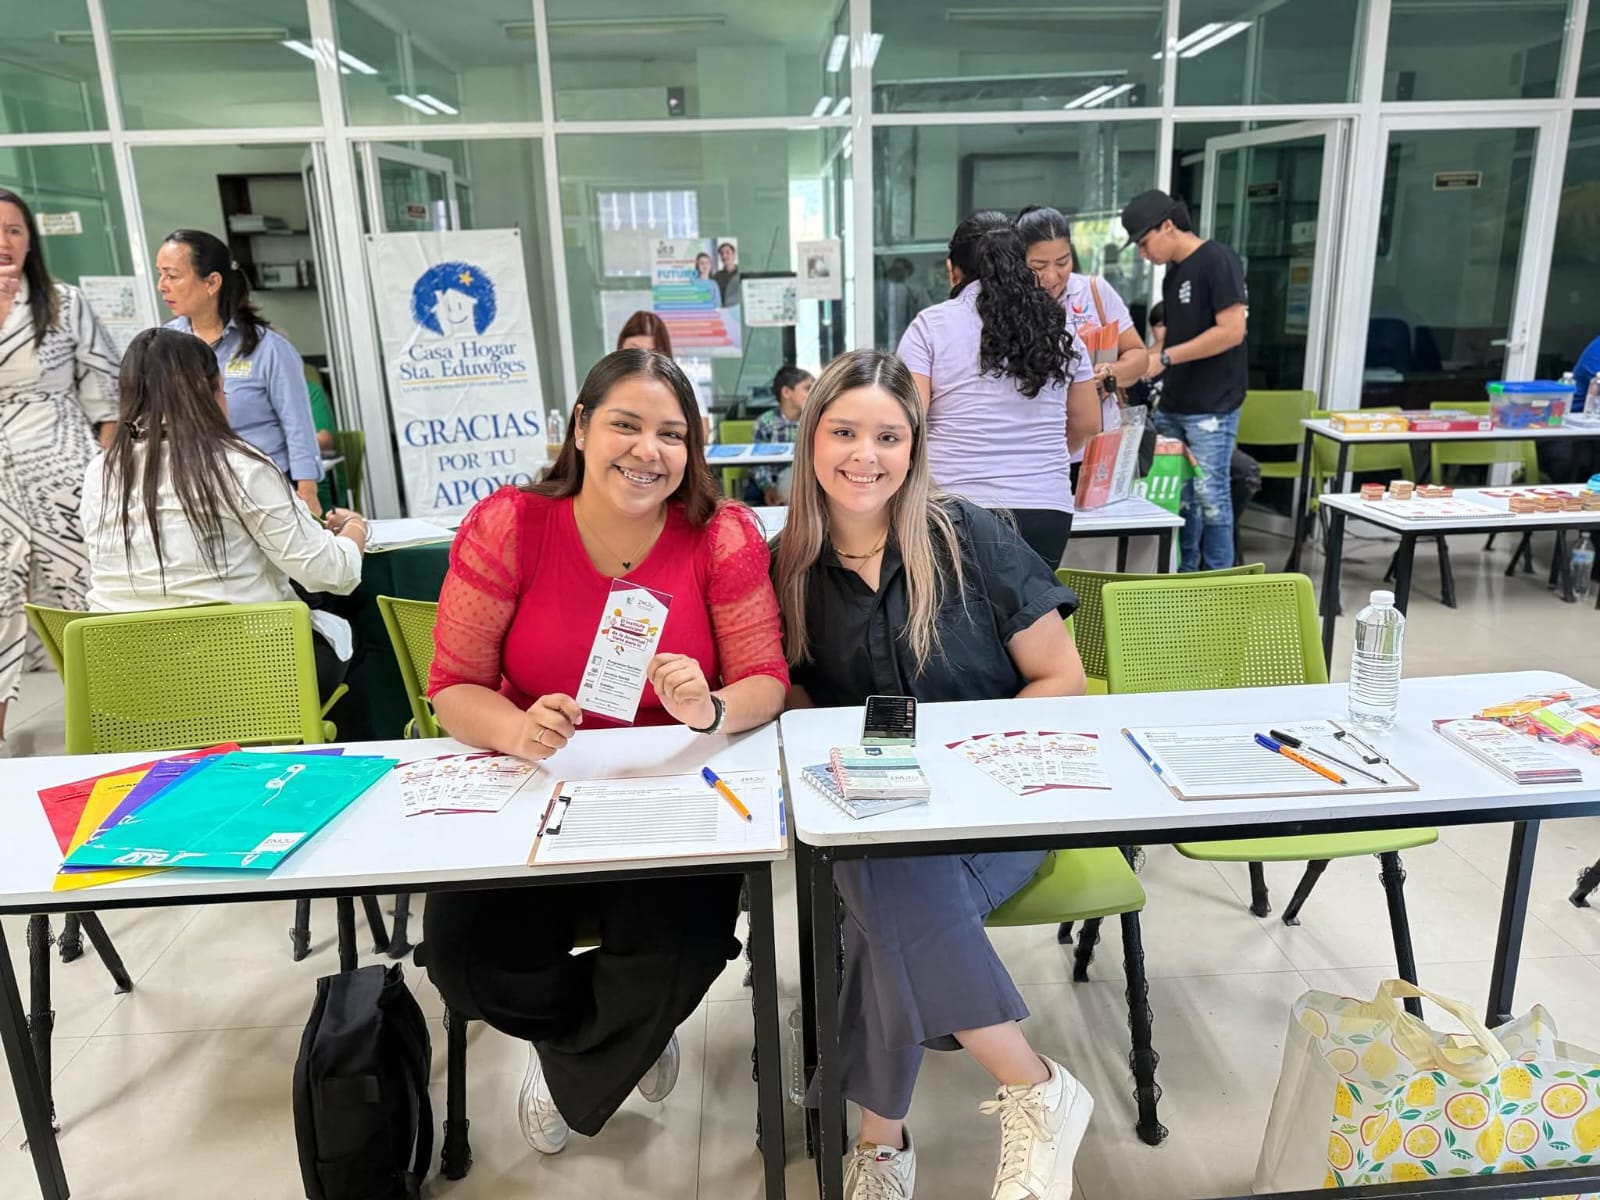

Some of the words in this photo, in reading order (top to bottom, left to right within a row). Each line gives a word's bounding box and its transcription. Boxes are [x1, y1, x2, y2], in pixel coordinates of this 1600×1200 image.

[408, 344, 454, 361] Casa
[461, 341, 517, 361] Hogar
[400, 362, 434, 380] Sta.
[440, 359, 526, 380] Eduwiges
[404, 410, 540, 447] GRACIAS
[438, 452, 482, 472] POR
[484, 448, 516, 467] TU
